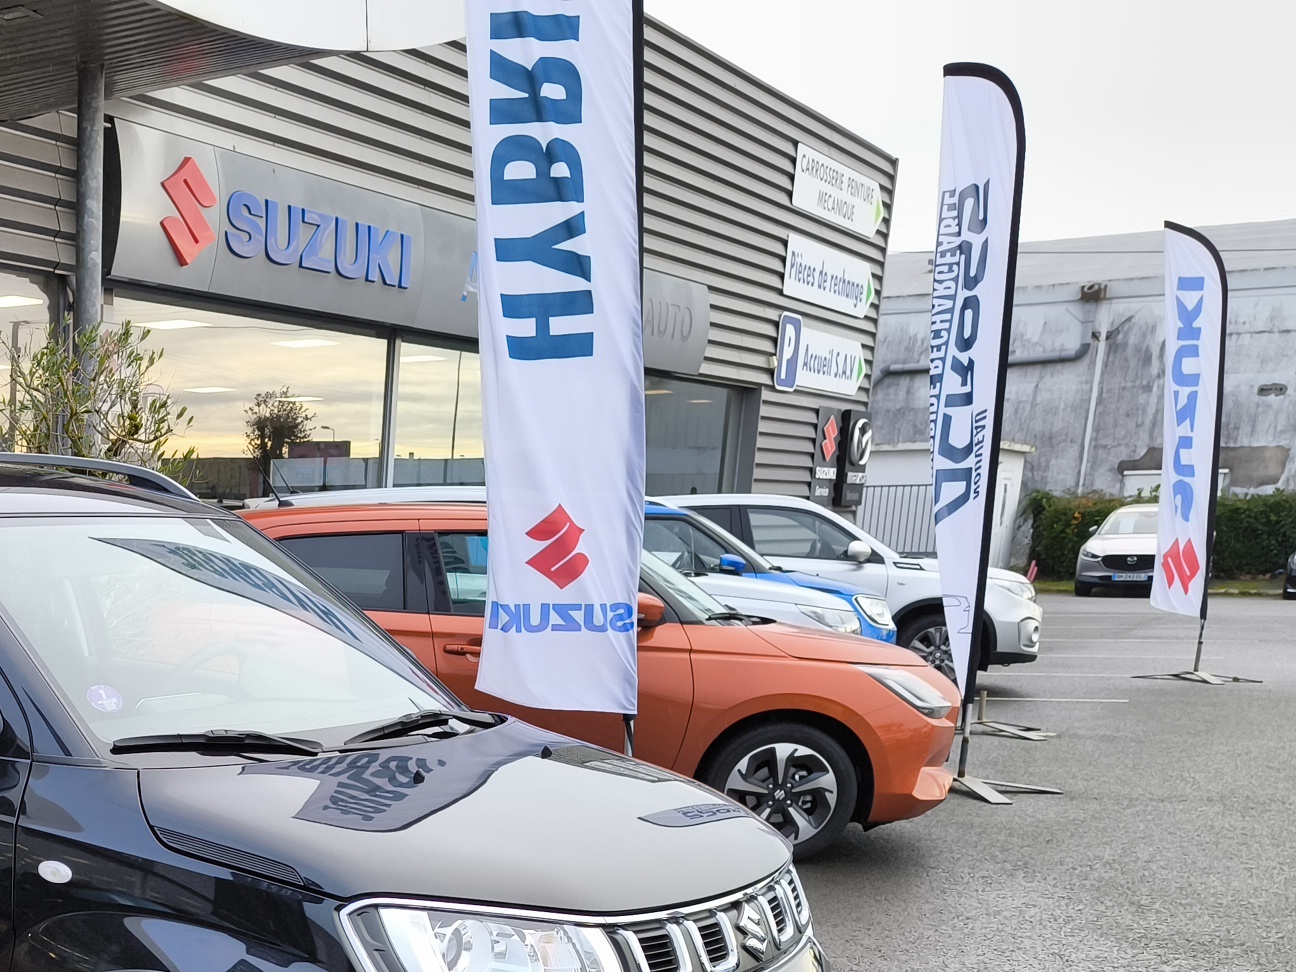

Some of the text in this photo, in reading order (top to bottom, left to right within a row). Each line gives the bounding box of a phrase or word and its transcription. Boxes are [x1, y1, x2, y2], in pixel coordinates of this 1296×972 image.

[800, 153, 875, 205] CARROSSERIE PEINTURE
[816, 189, 856, 222] MECANIQUE
[225, 190, 413, 290] SUZUKI
[789, 250, 864, 308] Pièces de rechange
[644, 298, 693, 343] AUTO
[781, 323, 796, 380] P
[802, 344, 834, 377] Accueil
[815, 466, 837, 480] SUZUKI
